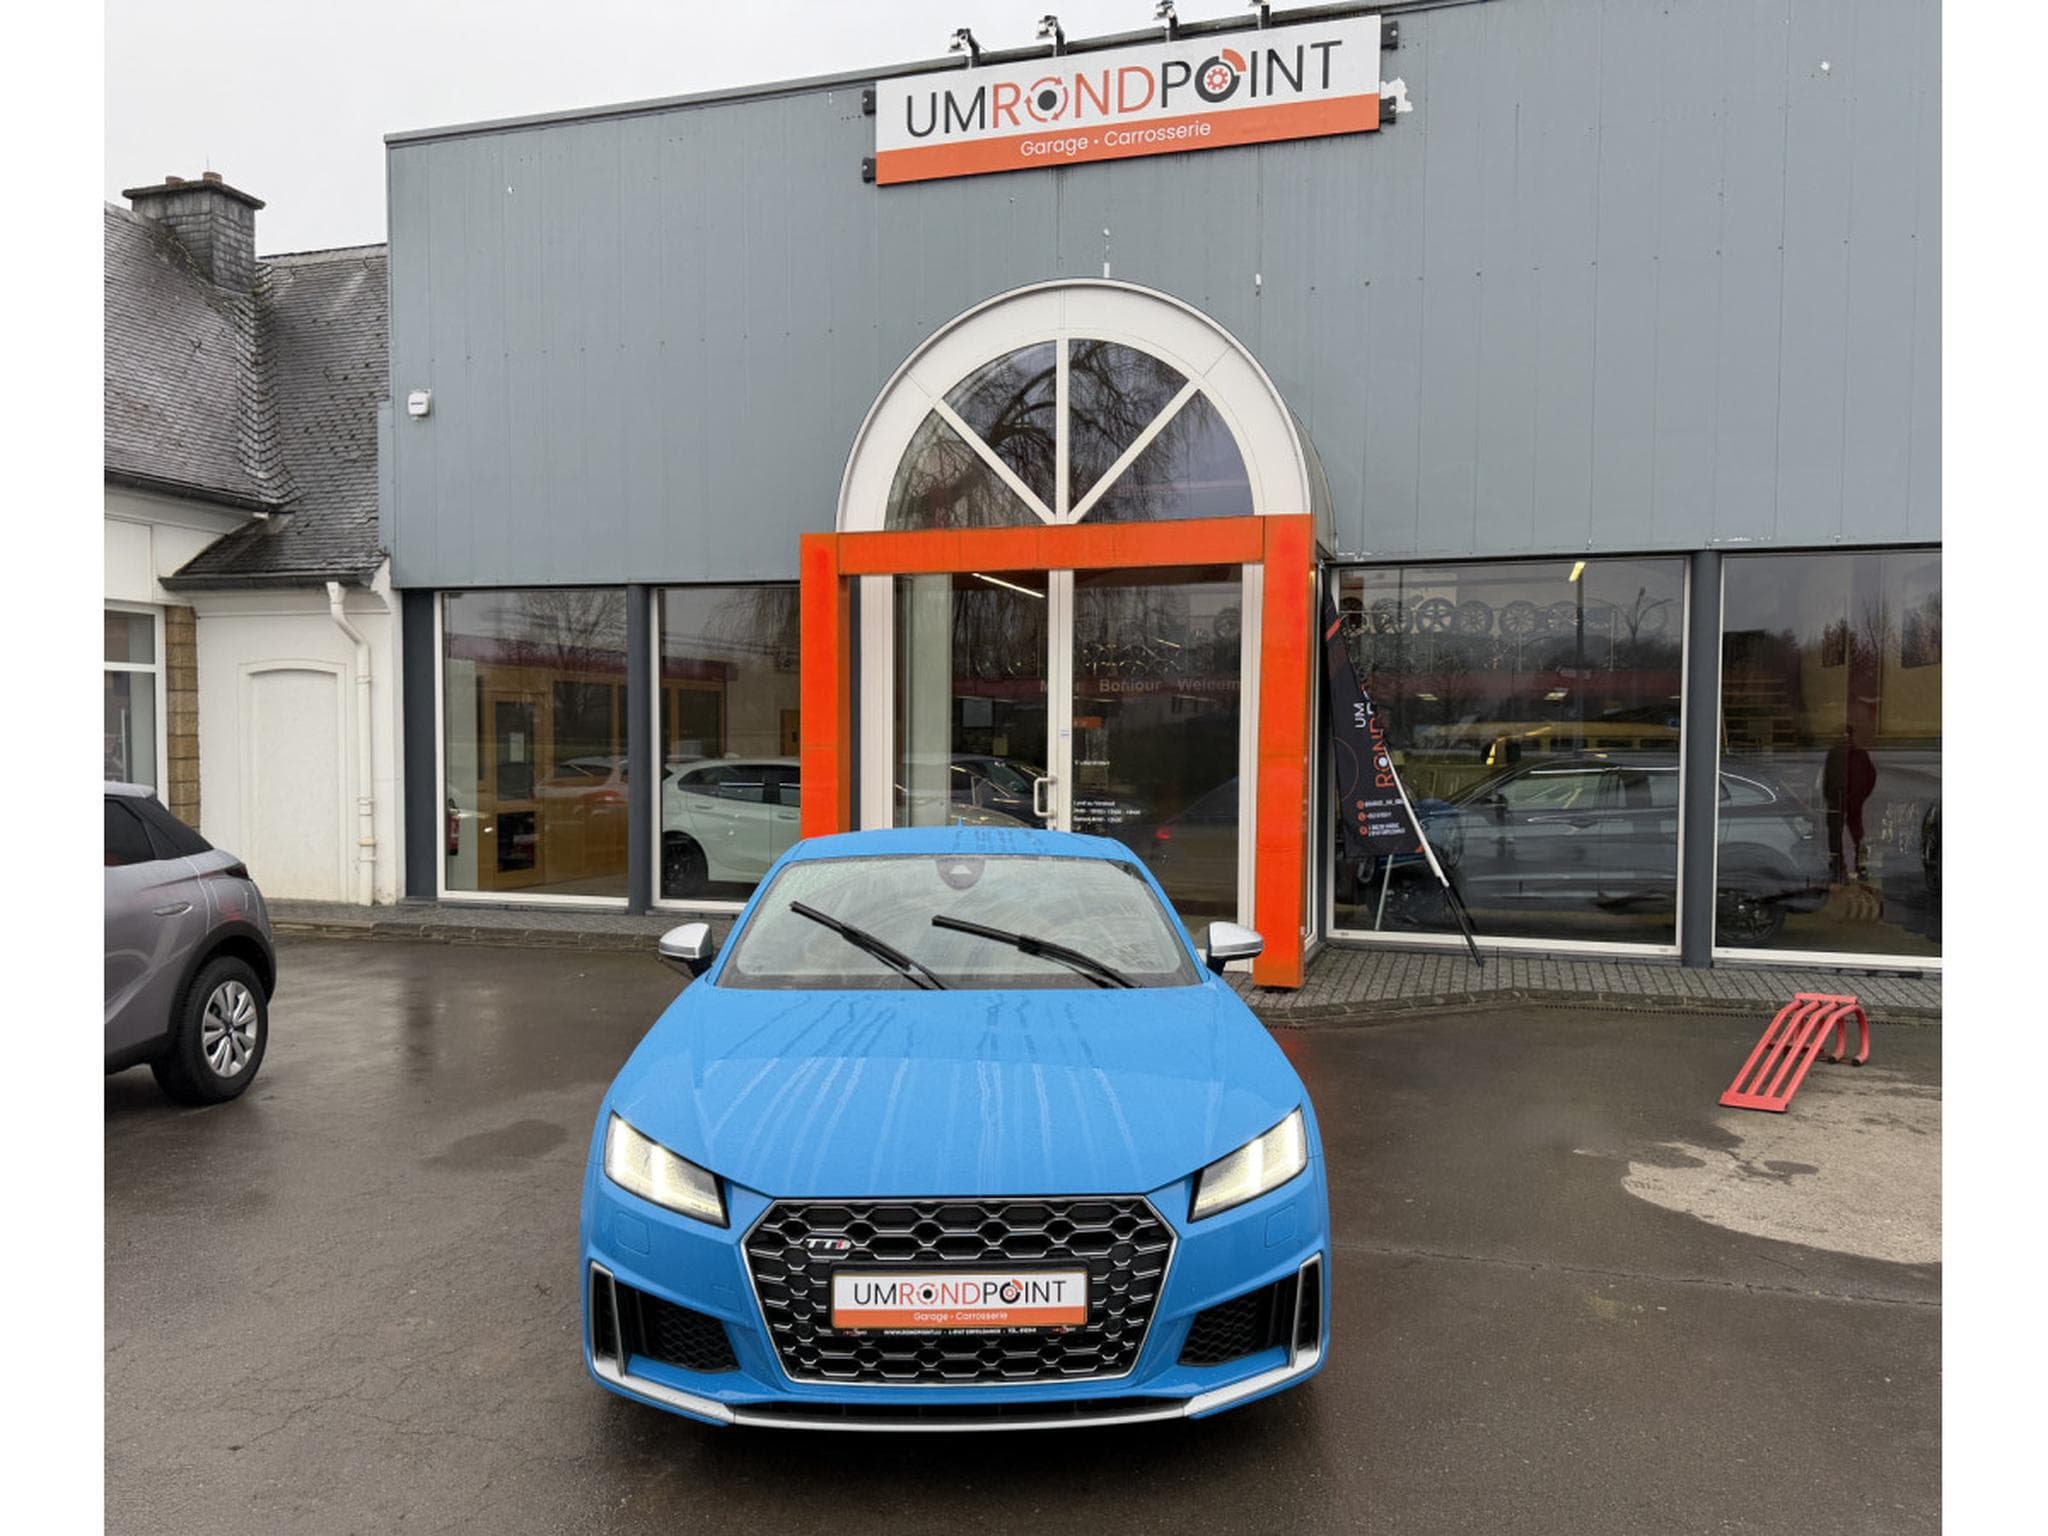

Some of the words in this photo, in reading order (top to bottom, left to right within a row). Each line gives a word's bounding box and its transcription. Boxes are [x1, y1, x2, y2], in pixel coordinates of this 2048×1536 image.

[1020, 136, 1089, 156] Garage
[1104, 120, 1212, 147] Carrosserie
[1099, 678, 1162, 694] Bonjour
[1353, 702, 1366, 728] UM
[913, 1311, 949, 1322] Garage
[955, 1310, 1008, 1321] Carrosserie
